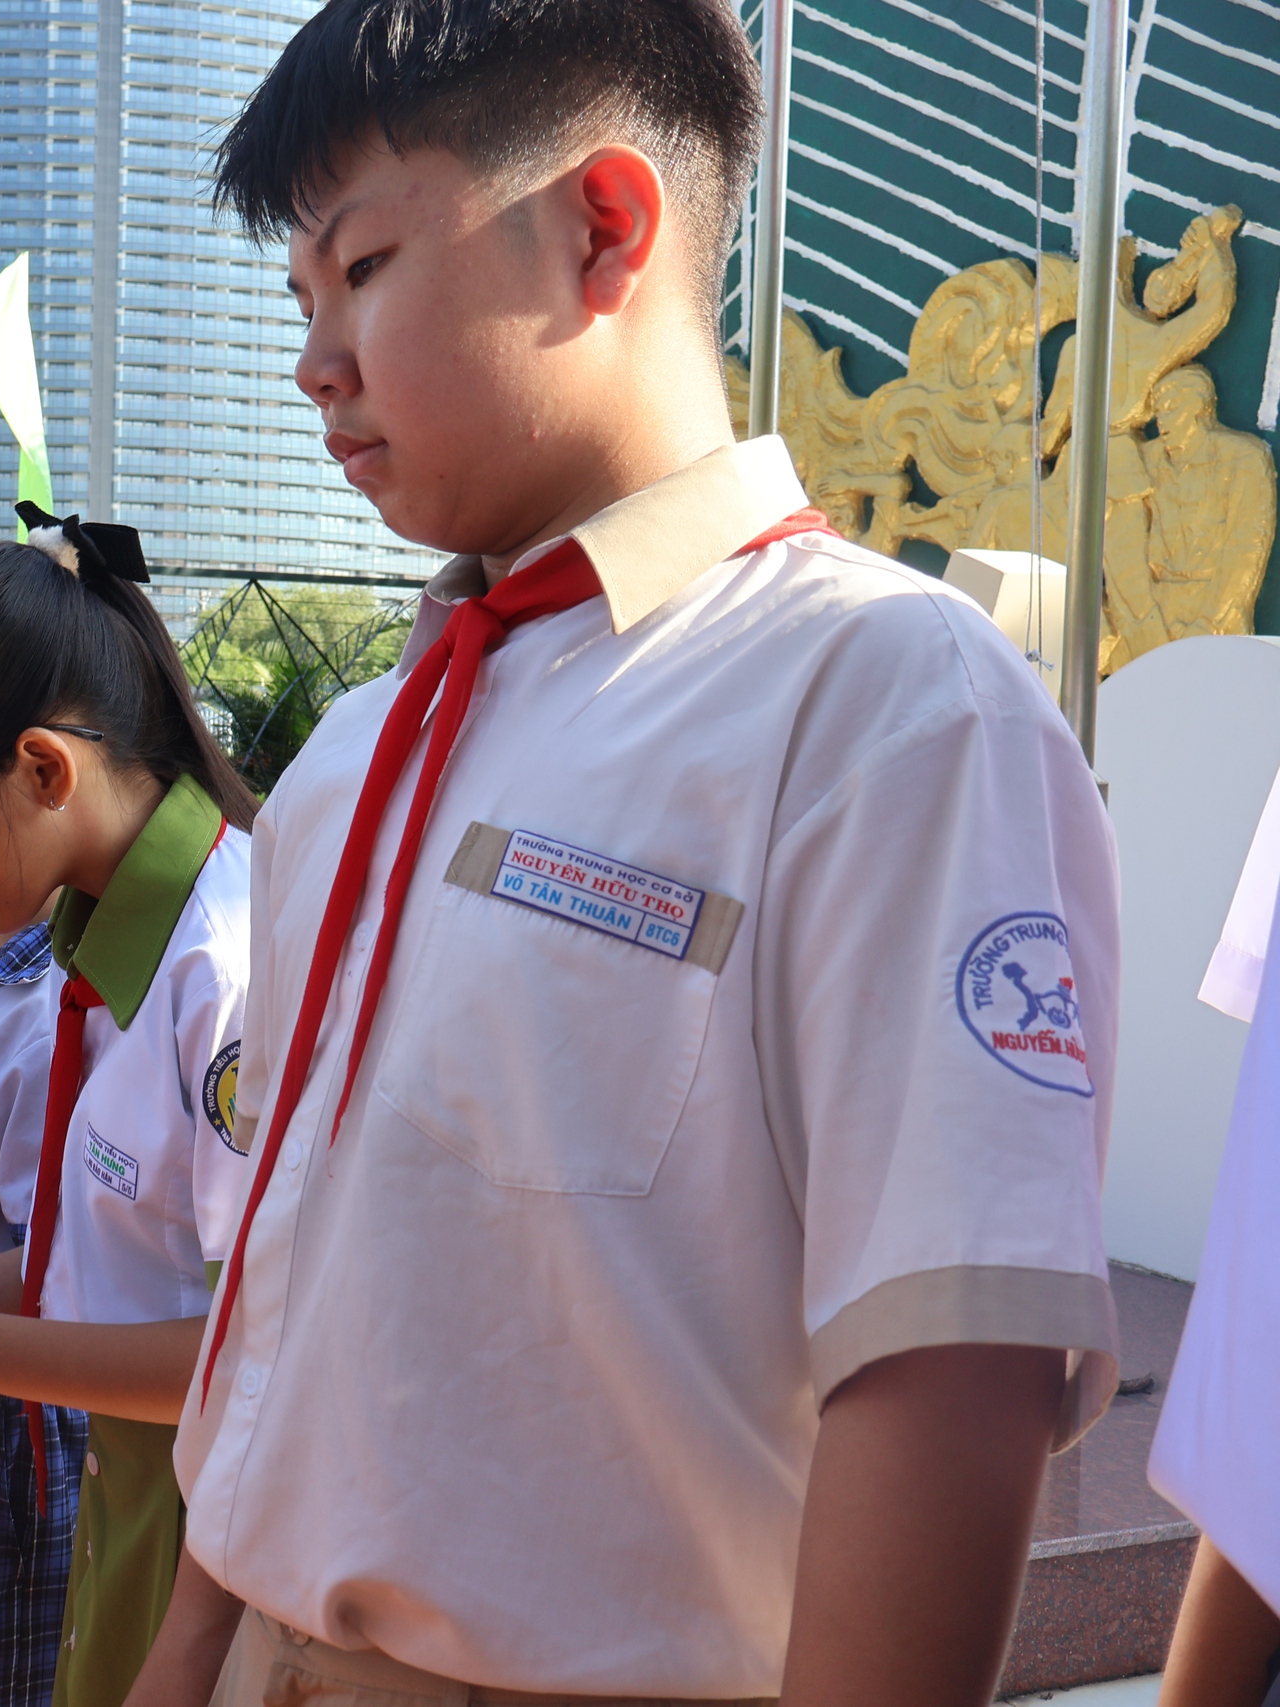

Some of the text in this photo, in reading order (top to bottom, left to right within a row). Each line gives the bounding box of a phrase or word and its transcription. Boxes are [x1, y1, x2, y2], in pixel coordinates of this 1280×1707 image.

[510, 850, 685, 921] NGUYỄN HỮU THỌ
[516, 836, 694, 904] TRƯỜNG TRUNG HỌC CƠ SỞ
[503, 873, 680, 947] VÕ TÂN THUẬN 8TC6
[969, 922, 1067, 1011] TRƯỜNG TRUNG
[992, 1029, 1062, 1054] NGUYỄN
[205, 1074, 217, 1113] TRƯỜNG
[213, 1055, 228, 1073] TIỂU
[101, 1153, 125, 1176] HƯNG
[104, 1145, 117, 1159] TIỂU
